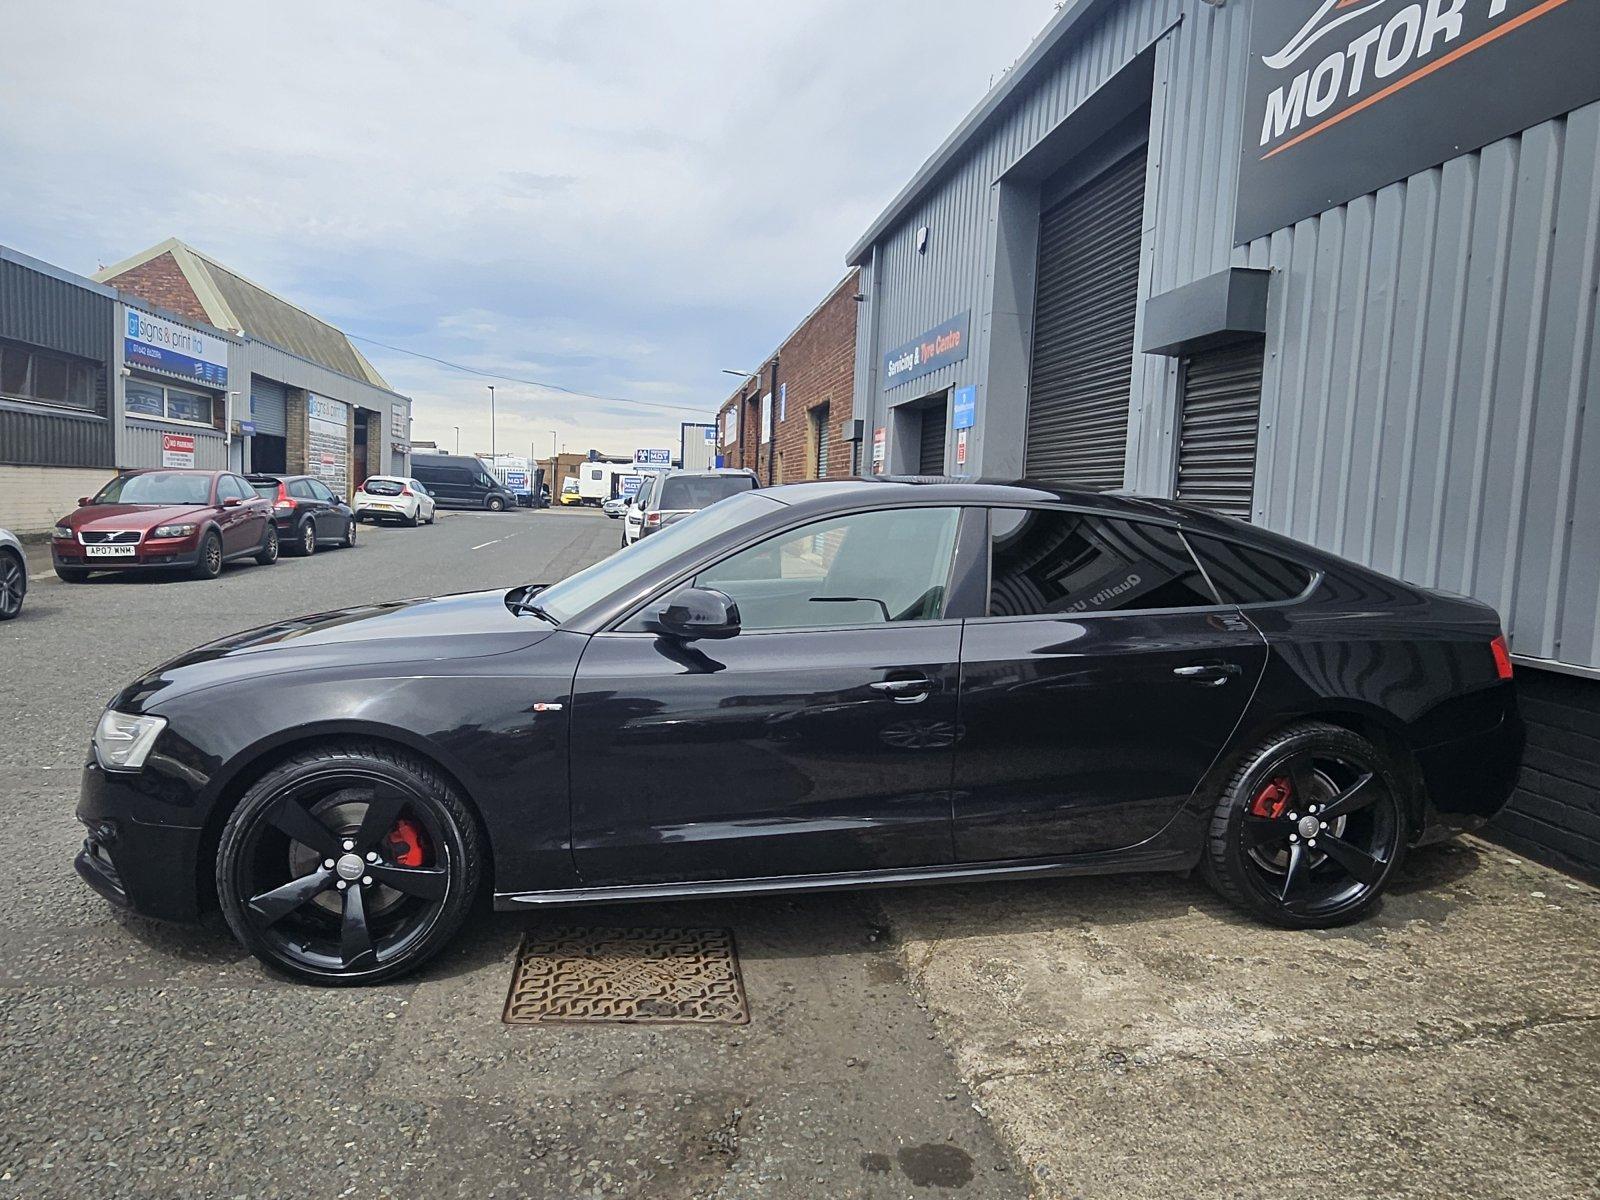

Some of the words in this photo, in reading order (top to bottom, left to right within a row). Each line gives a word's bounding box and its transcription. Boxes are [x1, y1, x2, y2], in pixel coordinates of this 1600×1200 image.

[1259, 0, 1463, 146] MOTOR
[139, 318, 162, 342] signs
[164, 326, 171, 344] &
[172, 331, 191, 349] print
[888, 352, 913, 377] Servicing
[913, 346, 920, 366] &
[921, 342, 935, 365] Tyre
[935, 331, 960, 355] Centre
[91, 547, 111, 555] AP07
